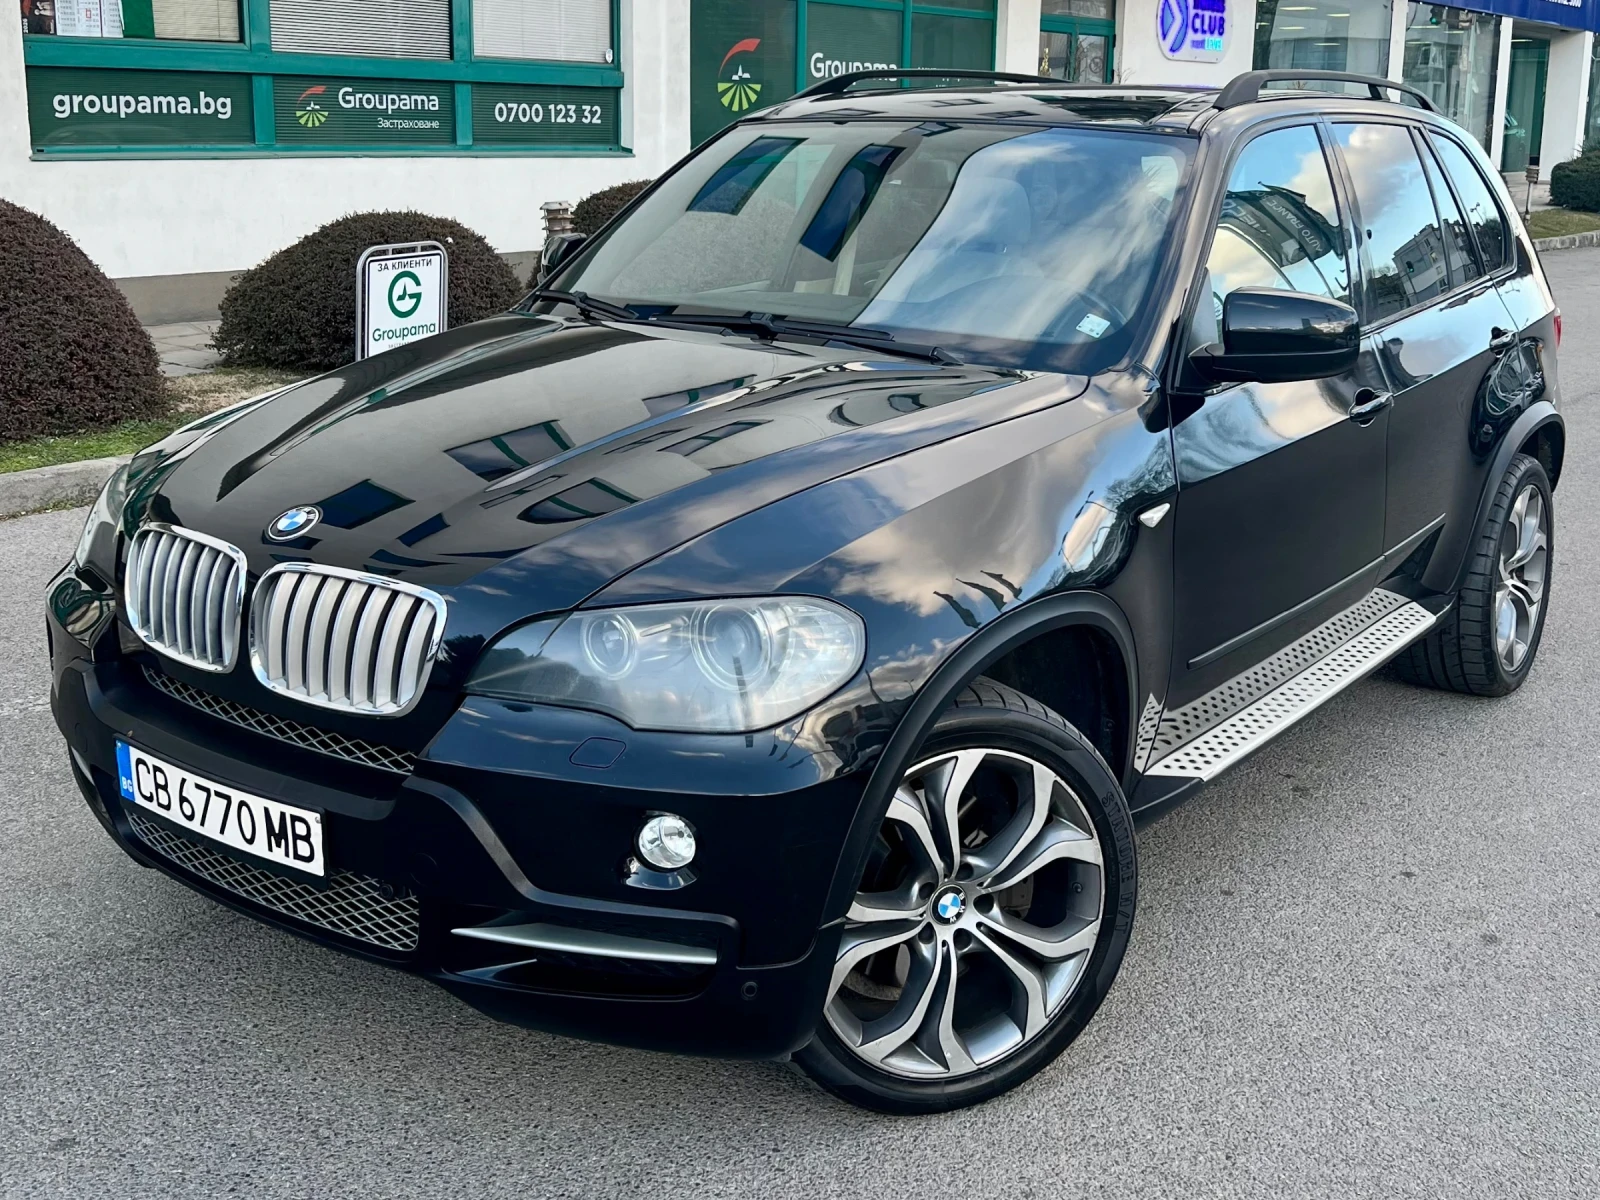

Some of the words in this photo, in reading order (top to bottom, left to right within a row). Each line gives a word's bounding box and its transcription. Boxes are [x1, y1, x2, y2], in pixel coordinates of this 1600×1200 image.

[1192, 12, 1225, 36] CLUB
[52, 91, 232, 119] groupama.bg
[338, 87, 439, 114] Groupama
[377, 117, 440, 130] Застраховане
[494, 102, 543, 123] 0700
[548, 104, 577, 123] 123
[581, 105, 602, 124] 32
[378, 263, 389, 271] ЗА
[391, 259, 432, 270] КЛИЕНТИ
[372, 322, 436, 342] Groupama
[121, 776, 133, 793] BG
[135, 757, 172, 812] CB
[178, 777, 257, 845] 6770
[263, 805, 315, 864] MB
[1101, 791, 1134, 884] STATURE
